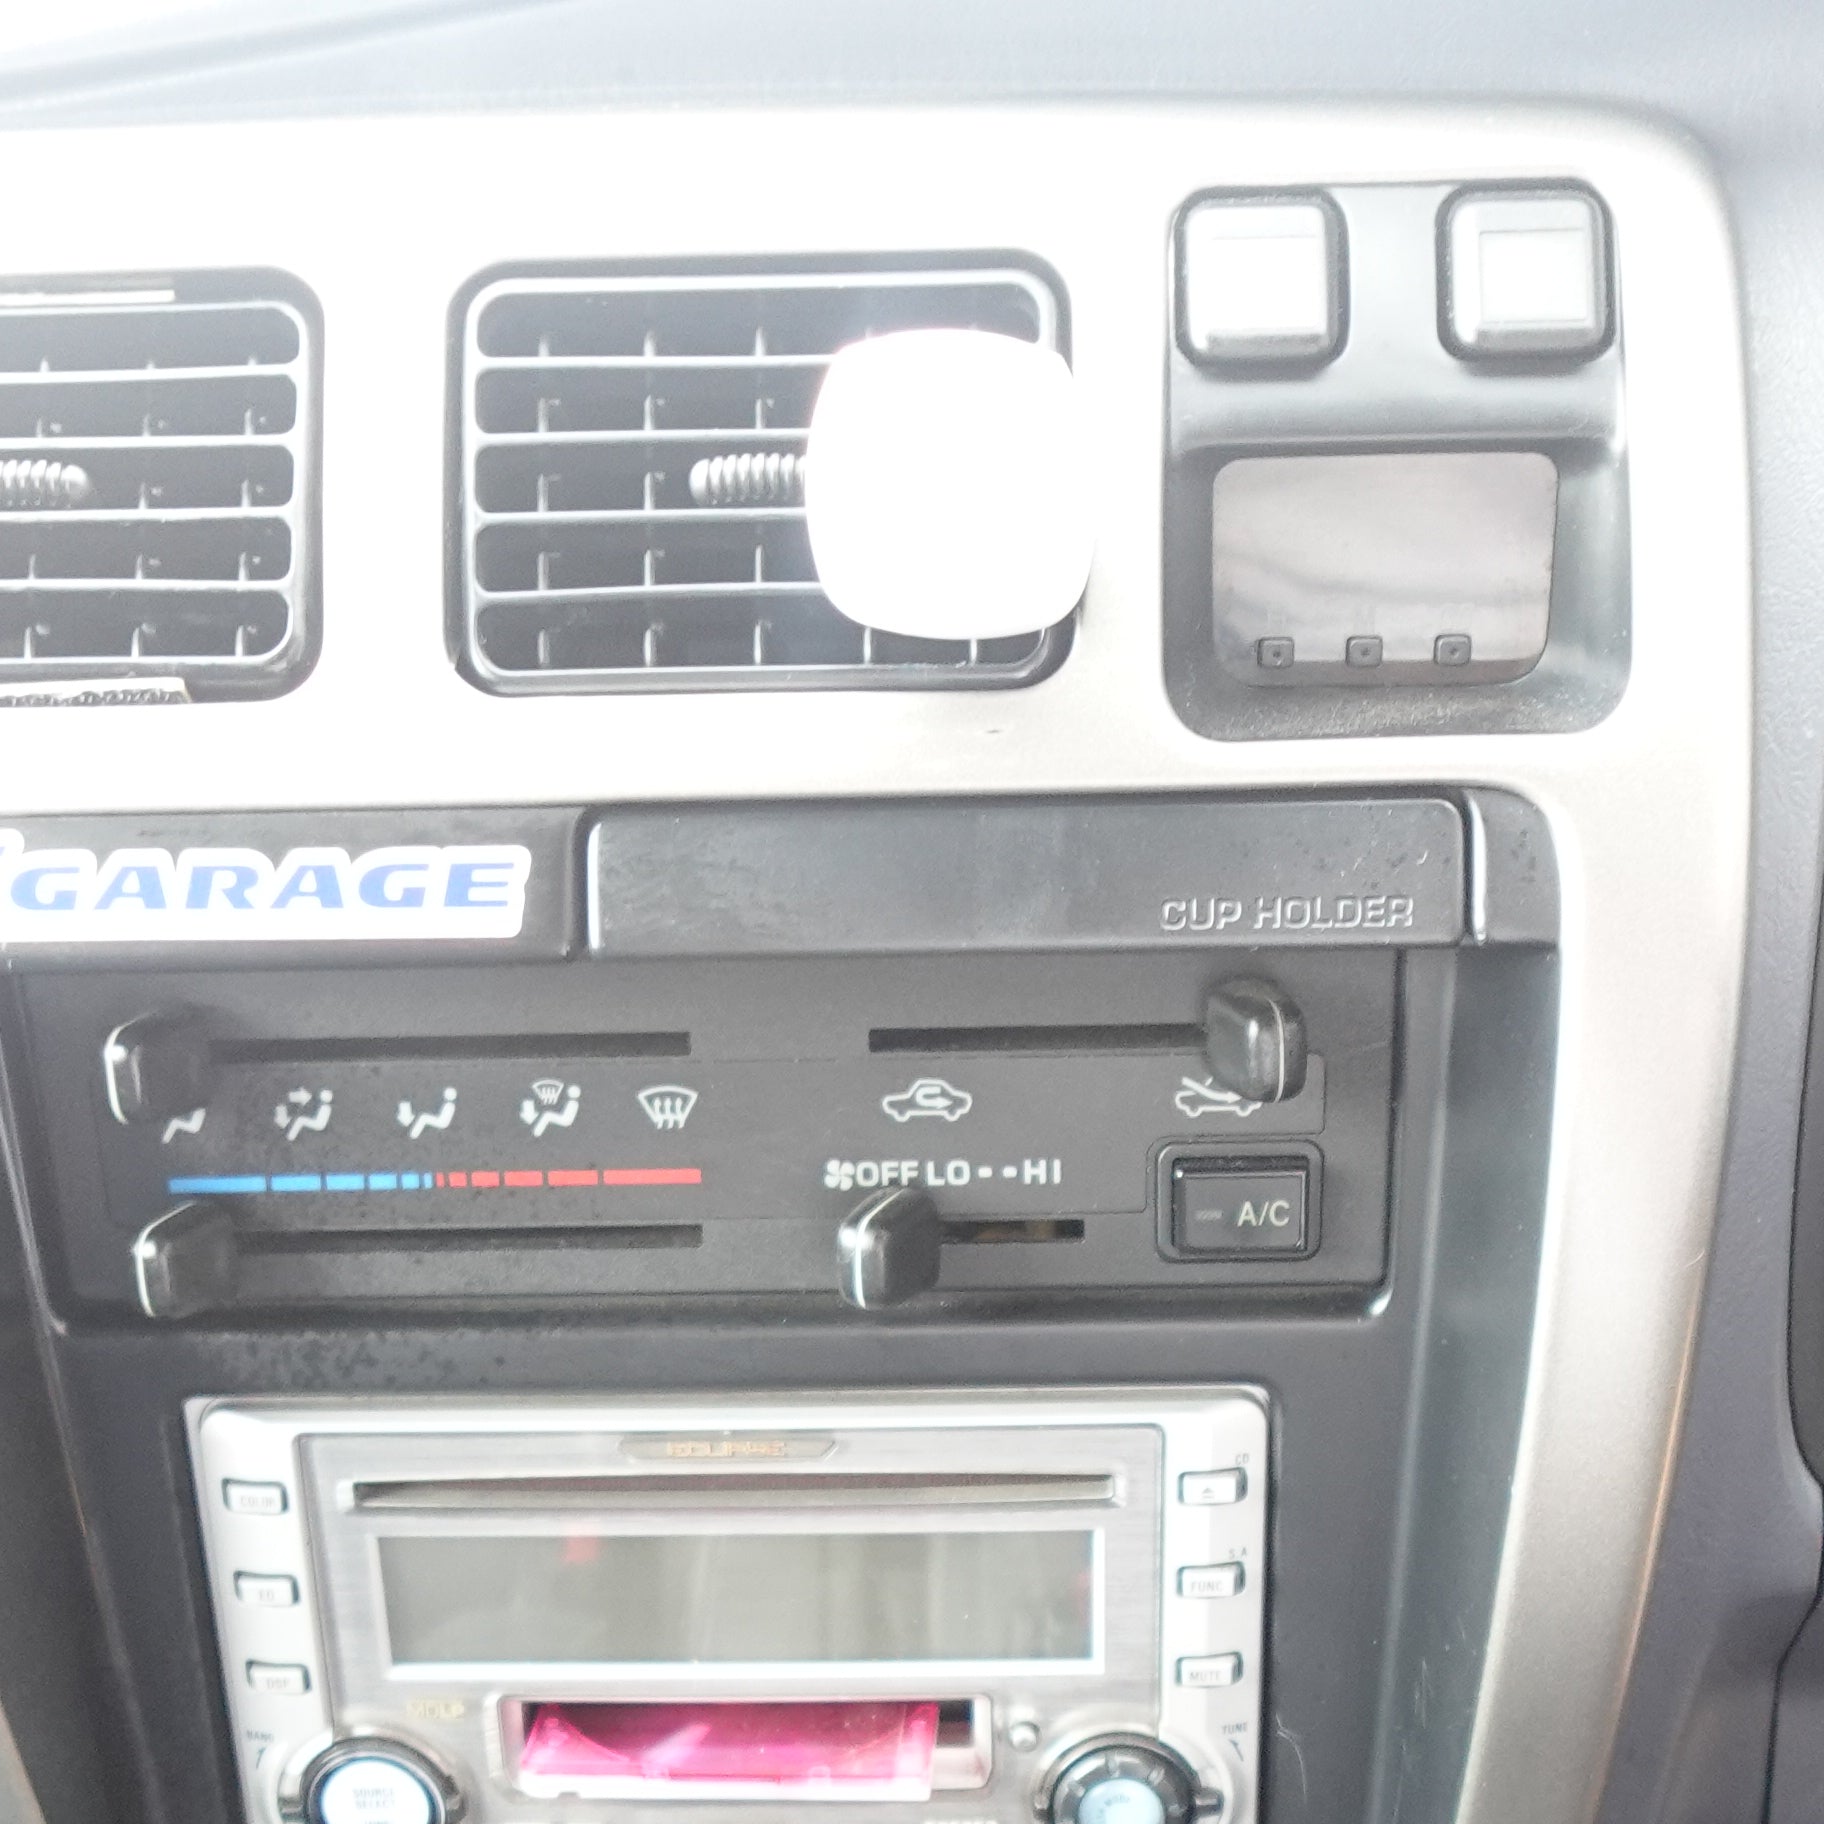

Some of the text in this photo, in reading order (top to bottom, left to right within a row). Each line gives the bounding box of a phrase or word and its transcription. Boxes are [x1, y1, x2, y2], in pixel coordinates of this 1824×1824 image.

[10, 861, 515, 912] GARAGE
[1160, 895, 1415, 931] CUP HOLDER
[856, 1159, 1062, 1186] OFF LO HI
[1236, 1200, 1291, 1228] A/C
[1189, 1671, 1222, 1682] MUTE
